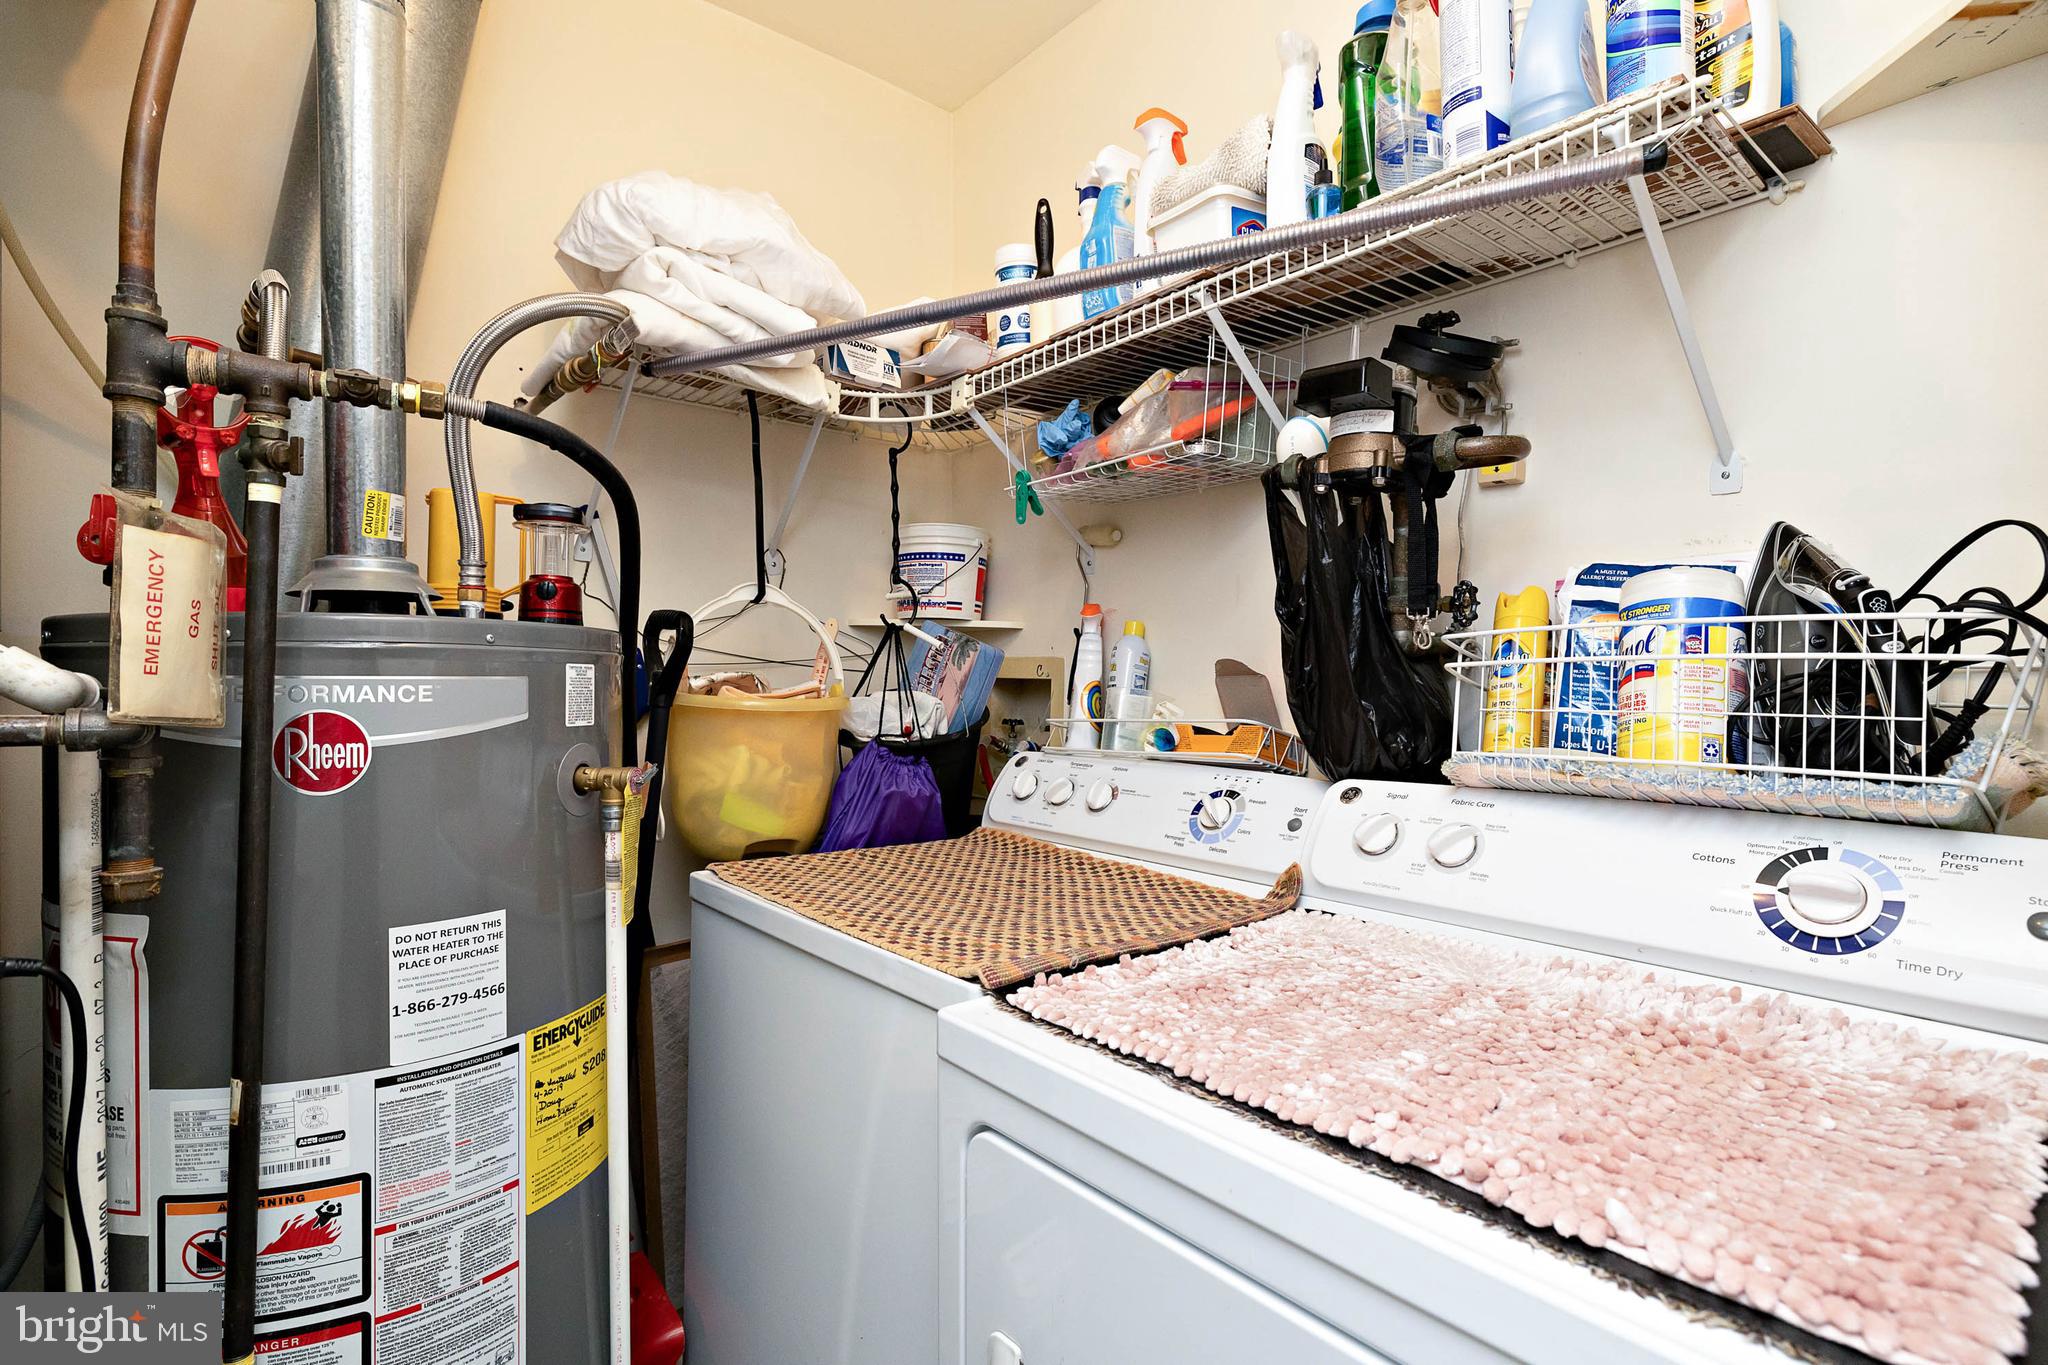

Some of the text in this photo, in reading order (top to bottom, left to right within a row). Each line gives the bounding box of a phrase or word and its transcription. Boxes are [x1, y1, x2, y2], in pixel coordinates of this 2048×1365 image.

[845, 340, 877, 353] ADNOR
[884, 364, 894, 374] XL
[364, 493, 376, 534] CAUTION:
[143, 548, 164, 676] EMERGENCY
[188, 599, 201, 638] GAS
[1628, 604, 1670, 618] STRONGER
[284, 713, 365, 781] Rheem
[1386, 792, 1409, 800] Signal
[1451, 798, 1495, 809] Fabric Care
[1747, 843, 1776, 851] Optimum
[1692, 852, 1736, 865] Cottons
[1940, 860, 1979, 872] Press
[1942, 851, 2024, 867] Permanent
[2028, 896, 2048, 906] Sta
[395, 919, 502, 945] DO NOT RETURN THIS
[392, 931, 504, 958] WATER HEATER TO THE
[398, 944, 499, 971] PLACE OF PURCHASE
[1896, 959, 1963, 981] Time Dry
[392, 982, 505, 1017] 1-866-279-4566
[533, 1001, 605, 1052] ENERGYGUIDE
[397, 1051, 503, 1082] INSTALLATION AND OPERATION DETAILS
[400, 1062, 501, 1093] AUTOMATIC STORAGE WATER HEATER
[534, 1084, 564, 1100] 4-20-19
[318, 1133, 341, 1143] CERTIFIED
[257, 1194, 305, 1208] RNING
[398, 1189, 501, 1229] FOR YOUR SAFETY READ BEFORE OPERATING
[257, 1252, 323, 1267] Flammable Vapors
[283, 1270, 310, 1279] HAZARD
[277, 1285, 306, 1294] flammable
[335, 1286, 350, 1294] other
[338, 1279, 361, 1289] gasoline
[424, 1282, 480, 1309] LIGHTING INSTRUCTIONS
